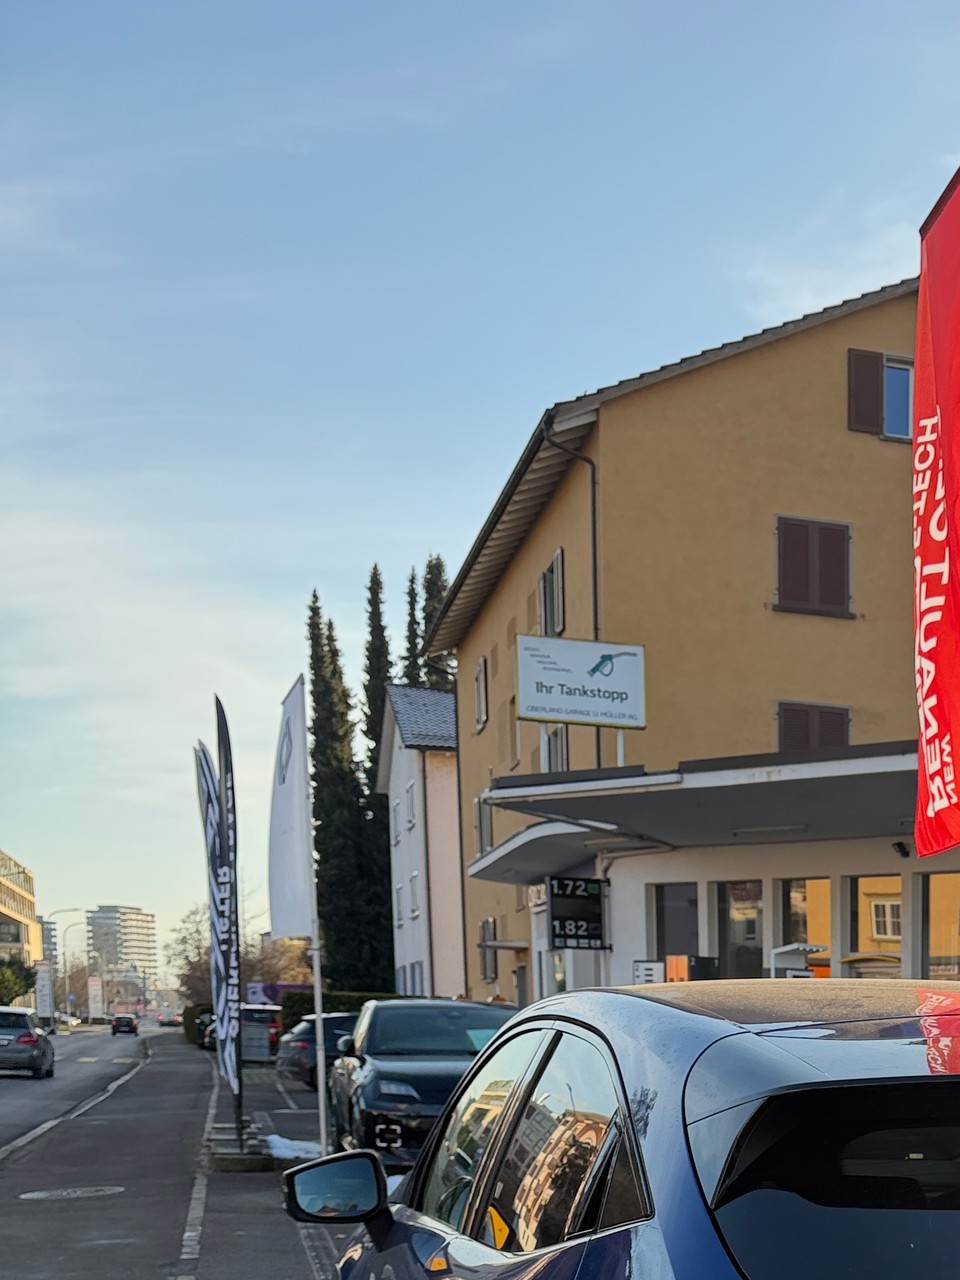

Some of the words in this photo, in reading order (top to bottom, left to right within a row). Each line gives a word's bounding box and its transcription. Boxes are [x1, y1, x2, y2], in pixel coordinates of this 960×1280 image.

[535, 681, 554, 694] Ihr
[558, 683, 629, 703] Tankstopp
[551, 880, 588, 896] 1.72
[553, 919, 588, 935] 1.82
